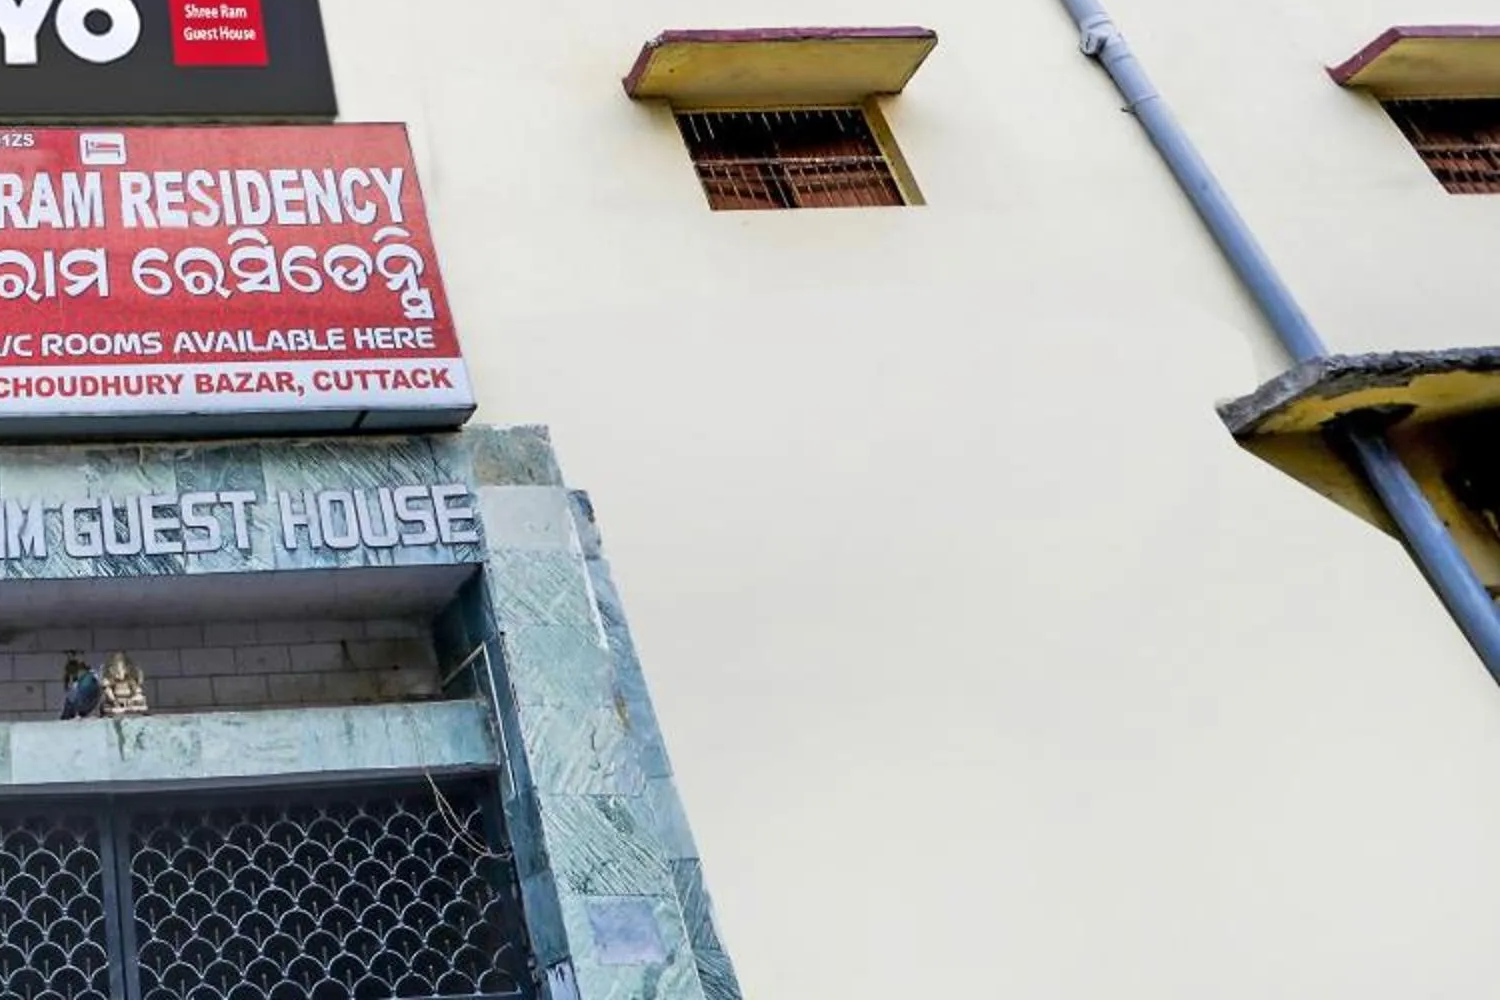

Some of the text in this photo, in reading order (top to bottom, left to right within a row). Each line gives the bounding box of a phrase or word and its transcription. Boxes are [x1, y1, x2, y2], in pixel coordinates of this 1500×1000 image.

[183, 3, 247, 19] Shree Ram
[183, 26, 256, 41] Guest House
[119, 167, 404, 229] RESIDENCY
[40, 332, 163, 356] ROOMS
[173, 327, 347, 354] AVAILABLE
[354, 326, 436, 350] HERE
[195, 372, 305, 397] BAZAR,
[312, 367, 454, 393] CUTTACK
[63, 491, 257, 557] GUEST
[278, 484, 479, 550] HOUSE
